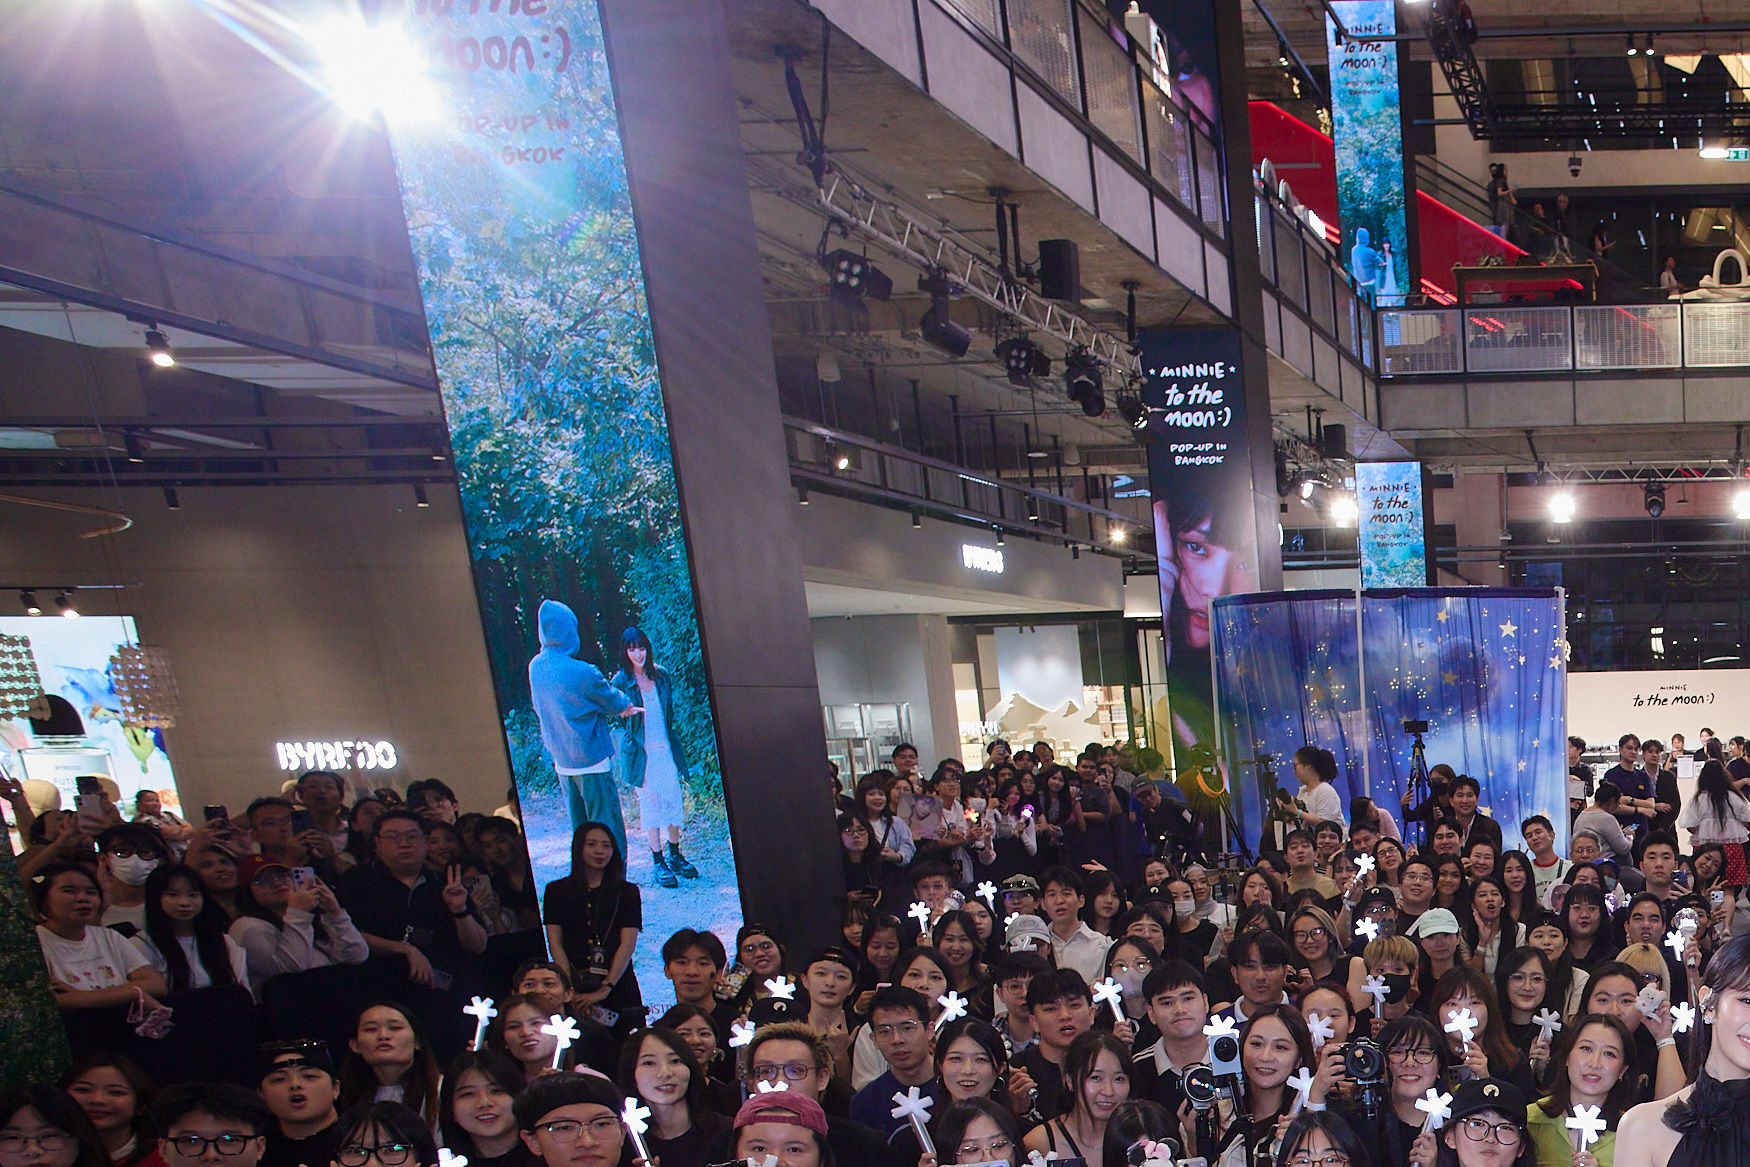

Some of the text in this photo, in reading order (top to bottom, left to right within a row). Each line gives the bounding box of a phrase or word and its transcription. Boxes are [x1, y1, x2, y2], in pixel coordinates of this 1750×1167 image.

[1345, 23, 1383, 34] INNIE
[1344, 41, 1382, 54] to the
[547, 115, 570, 132] IN
[1160, 361, 1226, 380] MINNIE
[1164, 381, 1225, 407] to the
[1169, 442, 1228, 454] POP-UP IN
[1174, 455, 1225, 466] BANGKOK
[1369, 482, 1411, 493] MINNIE
[1372, 495, 1410, 511] to the
[1633, 692, 1715, 708] to the moon:)
[276, 740, 398, 771] BYREDO
